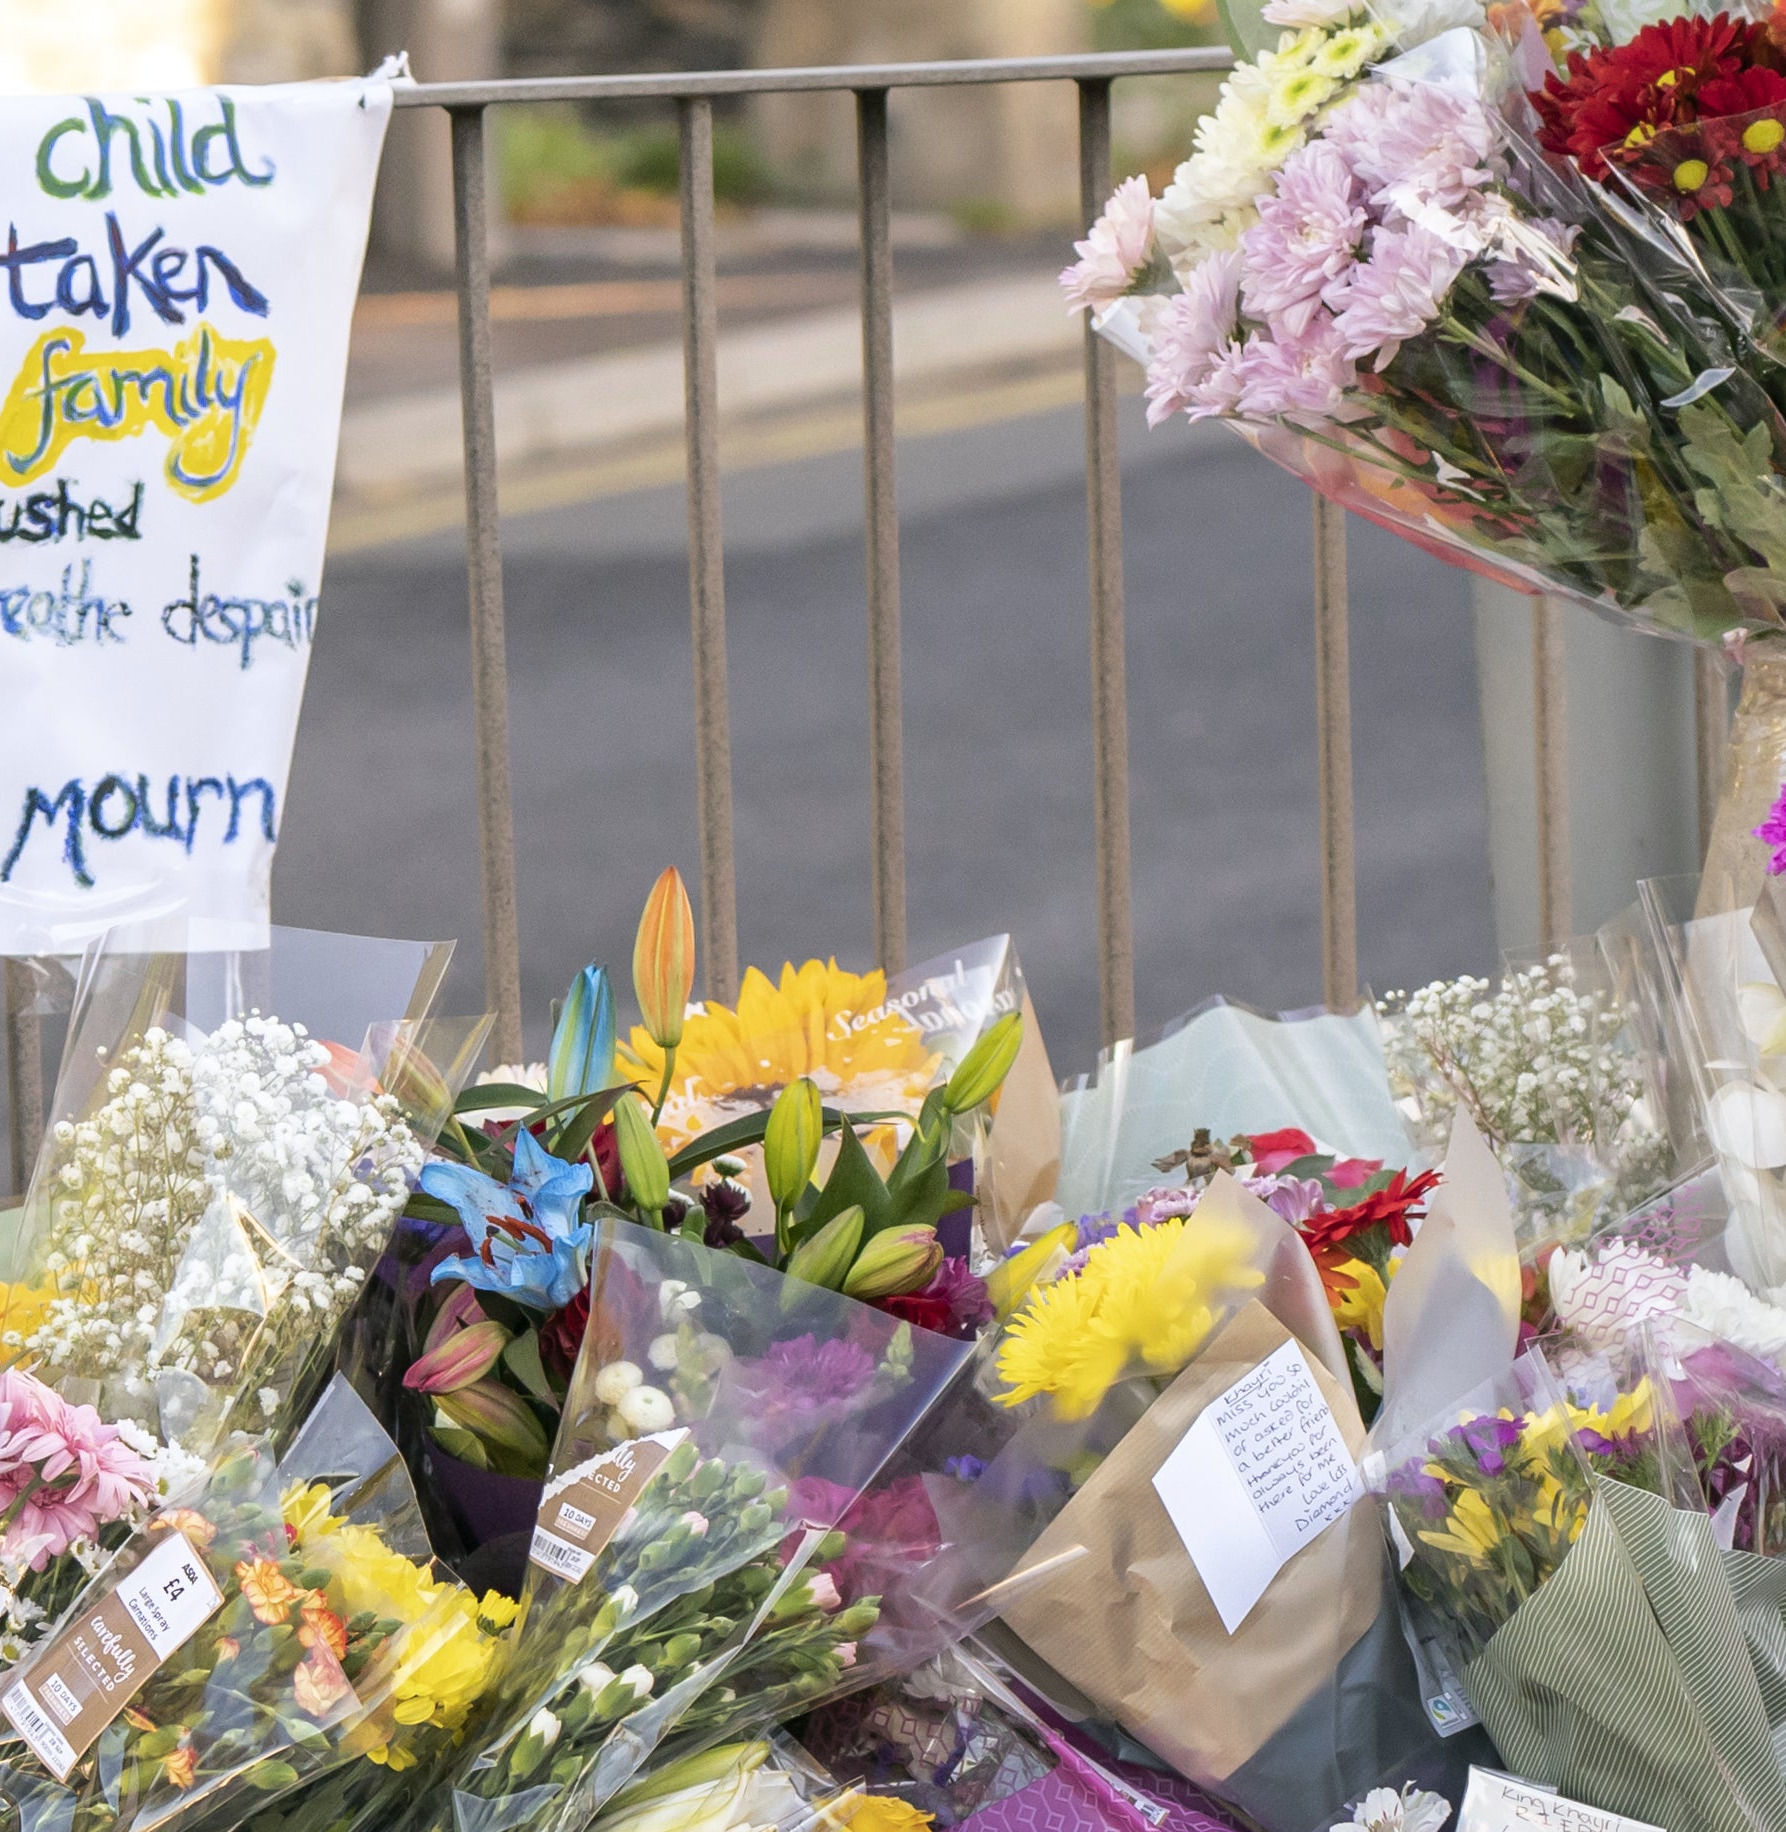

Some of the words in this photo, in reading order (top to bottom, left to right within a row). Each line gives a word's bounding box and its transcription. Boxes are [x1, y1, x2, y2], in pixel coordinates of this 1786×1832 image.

[36, 93, 277, 200] child
[5, 328, 265, 488] family
[574, 1515, 593, 1528] DAYS
[163, 1578, 185, 1602] £4
[181, 1563, 199, 1585] ASDA
[128, 1598, 159, 1641] Carnations
[139, 1586, 156, 1609] Large
[151, 1605, 170, 1632] Spray
[73, 1635, 116, 1692] SELECTED
[90, 1615, 135, 1684] carefully
[50, 1679, 60, 1693] 10
[59, 1690, 79, 1712] DAYS
[1502, 1786, 1550, 1816] King
